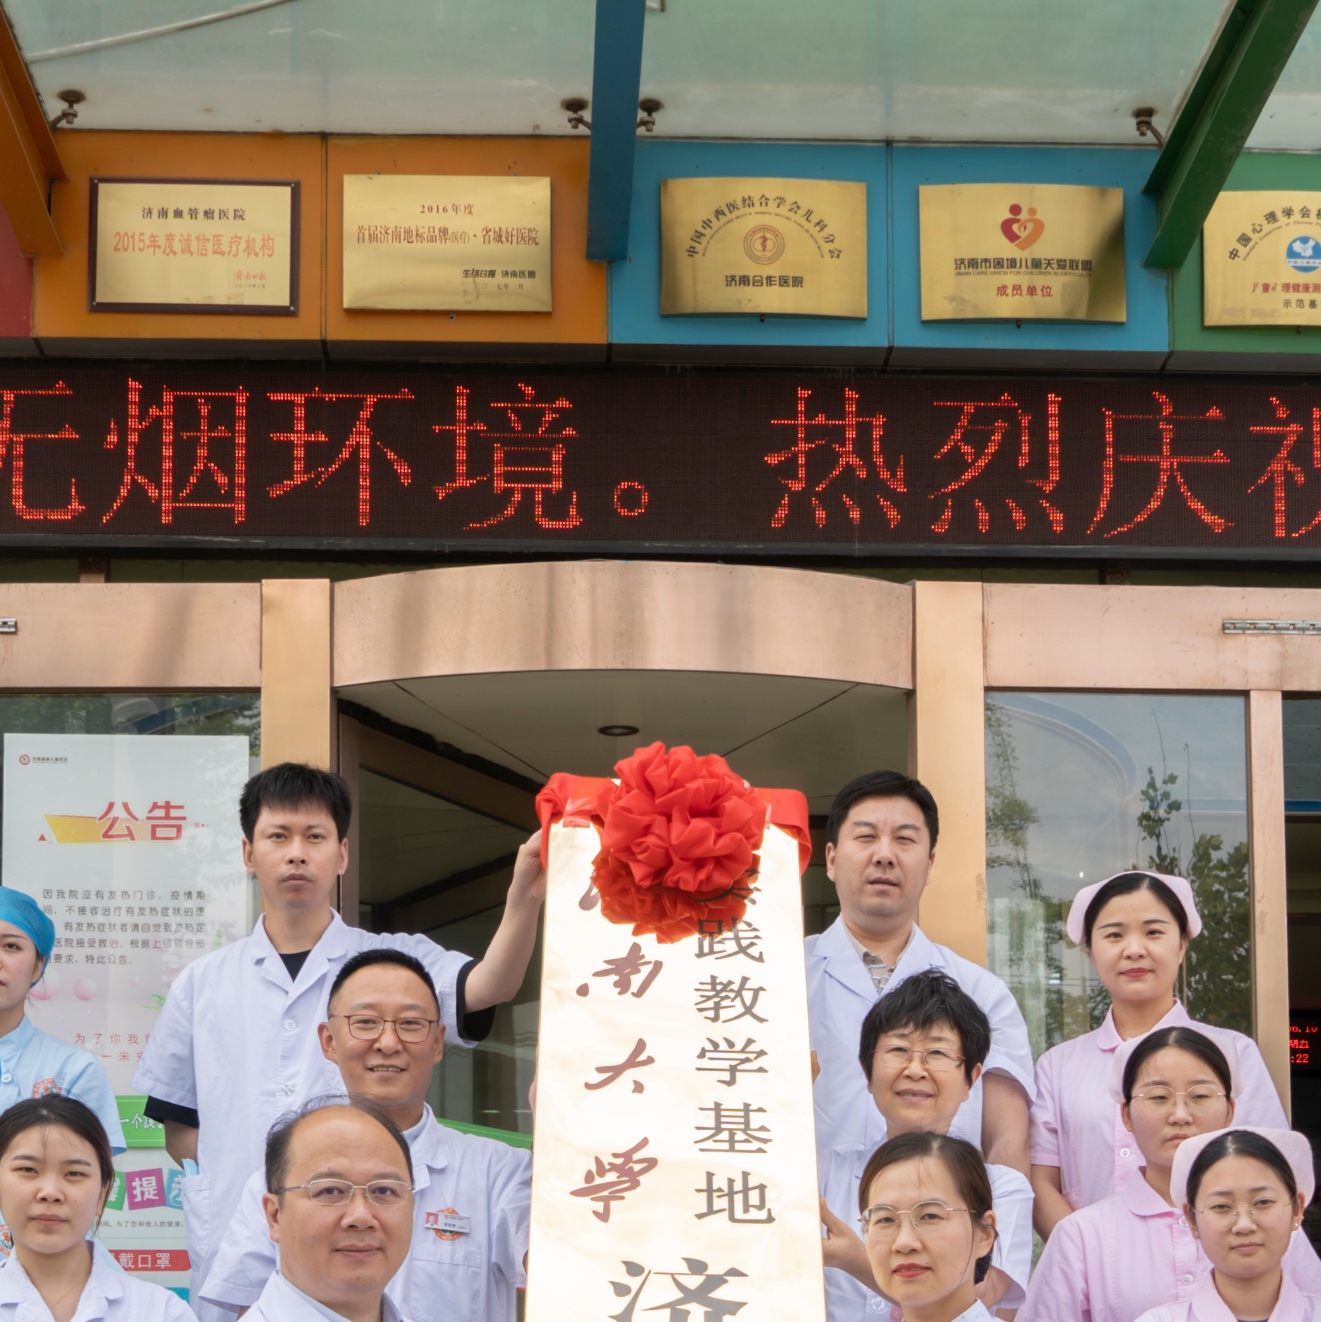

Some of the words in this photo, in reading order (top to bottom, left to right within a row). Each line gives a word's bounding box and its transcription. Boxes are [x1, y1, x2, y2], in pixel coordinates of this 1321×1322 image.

[142, 207, 246, 221] 济南血管瘤医院
[420, 203, 474, 215] 2016年度
[686, 194, 842, 260] 中国中西医结合学会儿科分会
[113, 232, 275, 258] 2015年度诚信医疗机构
[954, 257, 1093, 272] 济南市困境儿童关爱联盟
[725, 275, 804, 289] 济南合作医院
[996, 284, 1053, 297] 成员单位
[96, 800, 187, 841] 公告
[111, 1252, 171, 1269] 戴口罩
